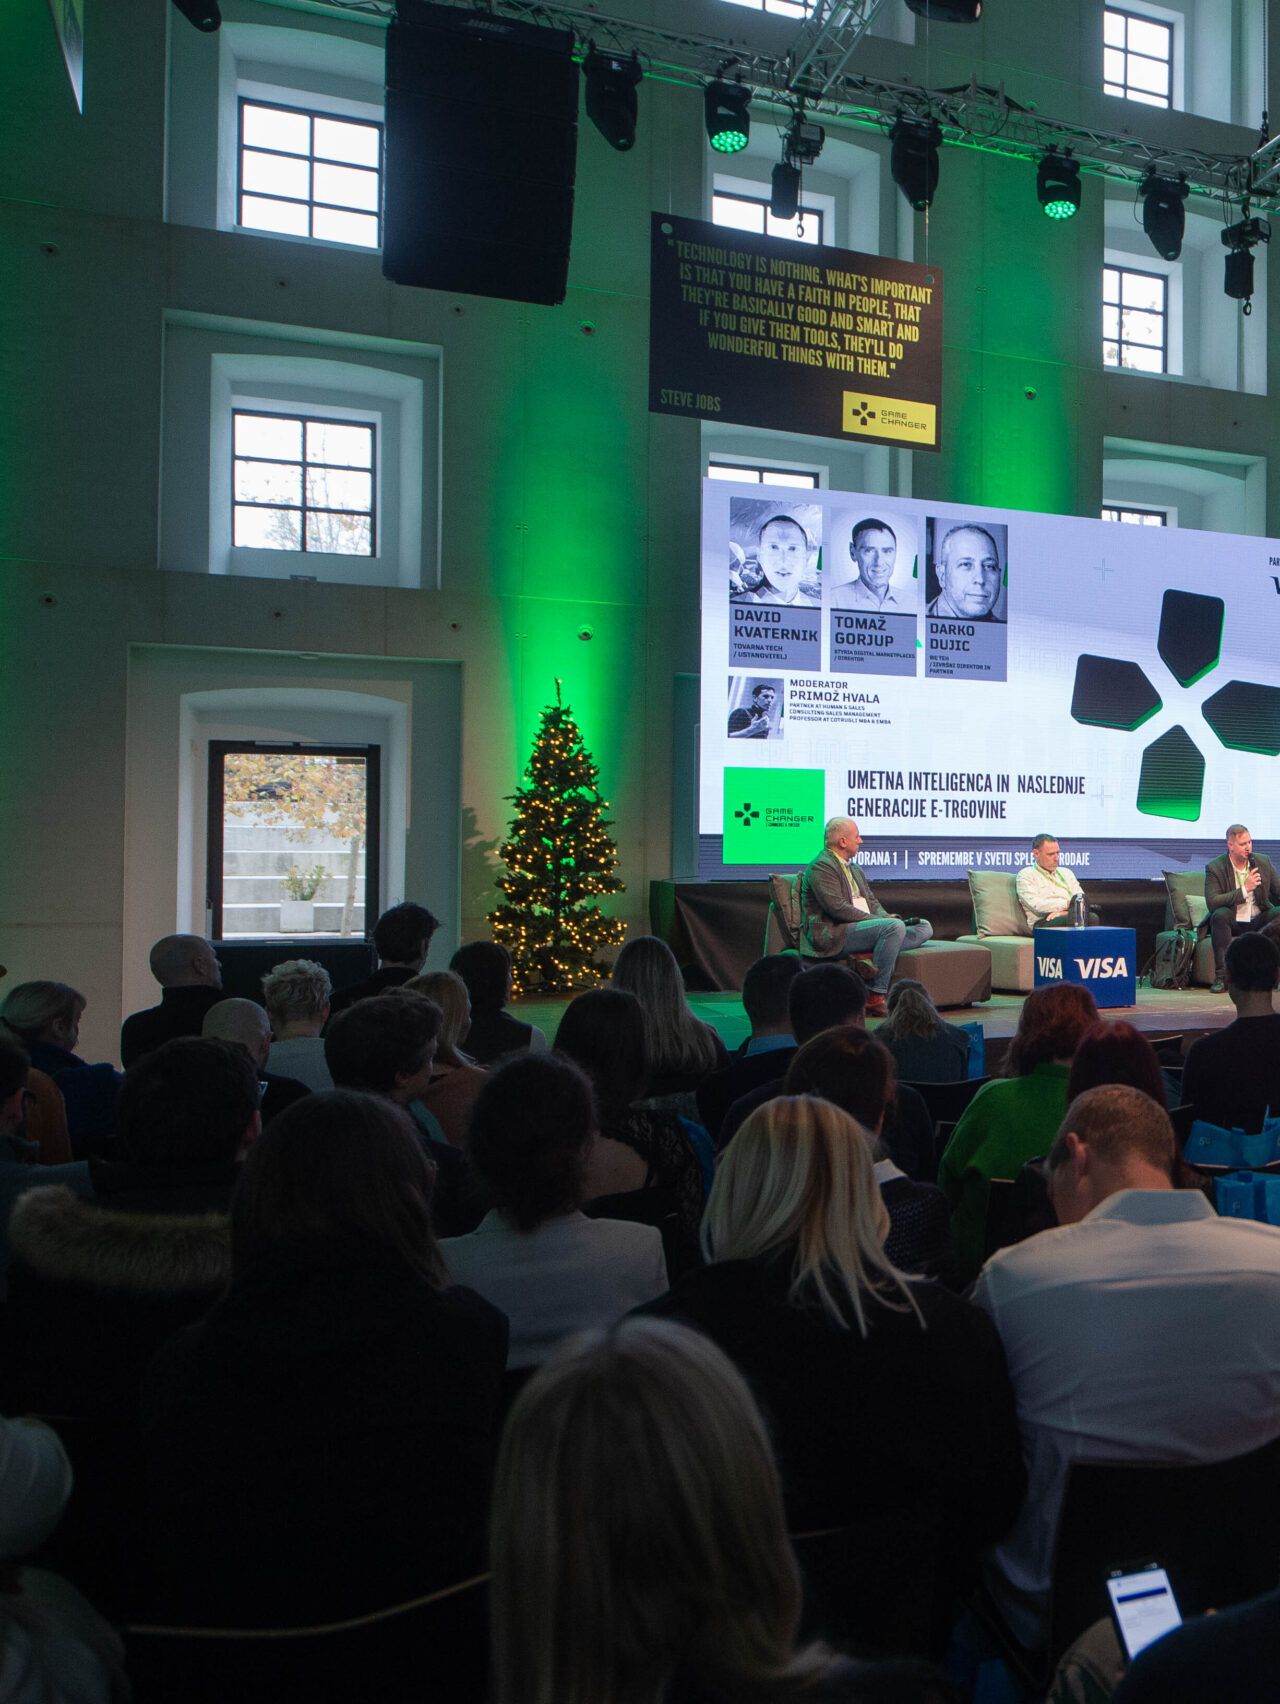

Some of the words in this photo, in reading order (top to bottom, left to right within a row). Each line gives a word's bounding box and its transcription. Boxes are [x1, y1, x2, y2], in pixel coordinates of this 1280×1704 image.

[755, 256, 767, 273] IS
[770, 257, 823, 284] NOTHING.
[826, 269, 868, 292] WHAT'S
[870, 278, 933, 305] IMPORTANT
[679, 262, 692, 280] IS
[695, 265, 727, 286] THAT
[728, 271, 752, 291] YOU
[755, 276, 785, 298] HAVE
[787, 282, 797, 300] A
[799, 283, 831, 307] FAITH
[834, 288, 846, 308] IN
[848, 291, 891, 319] PEOPLE,
[894, 302, 922, 323] THAT
[681, 284, 730, 309] THEY'RE
[732, 291, 794, 319] BASICALLY
[797, 303, 827, 326] GOOD
[830, 309, 854, 330] AND
[856, 316, 894, 340] SMART
[897, 324, 920, 342] AND
[699, 309, 710, 327] IF
[713, 311, 737, 333] YOU
[740, 317, 766, 338] GIVE
[769, 321, 800, 342] THEM
[803, 327, 842, 352] TOOLS,
[843, 333, 887, 358] THEY'LL
[888, 341, 904, 360] DO
[708, 332, 779, 360] WONDERFUL
[781, 344, 823, 367] THINGS
[826, 351, 854, 372] WITH
[856, 358, 896, 379] THEM."
[660, 389, 693, 409] STEVE
[695, 393, 721, 412] JOBS
[880, 409, 908, 420] GAME
[880, 417, 928, 431] CHANGER
[734, 609, 781, 623] DAVID
[834, 616, 887, 632] TOMAŽ
[930, 622, 975, 637] DARKO
[734, 625, 818, 642] KVATERNIK
[834, 632, 894, 647] GORJUP
[733, 642, 765, 651] TOVARNA
[766, 644, 783, 652] TECH
[930, 638, 970, 652] DUJIC
[738, 651, 788, 660] USTANOVITELJ
[790, 679, 848, 690] MODERATOR
[790, 690, 840, 702] PRIMOŽ
[842, 693, 880, 704] HVALA
[847, 769, 905, 791] UMETNA
[908, 771, 993, 793] INTELIGENCA
[996, 774, 1010, 793] IN
[1017, 775, 1086, 795] NASLEDNJE
[765, 807, 794, 815] GAME
[847, 797, 927, 819] GENERACIJE
[931, 799, 1007, 820] E-TRGOVINE
[765, 815, 815, 823] CHANGER
[849, 851, 891, 866] VORANA
[892, 851, 898, 866] 1
[918, 851, 974, 866] SPREMEMBE
[976, 852, 983, 866] V
[984, 852, 1012, 867] SVETU
[1058, 852, 1090, 867] RODAJE
[1036, 956, 1063, 979] VISA
[1073, 957, 1129, 979] VISA
